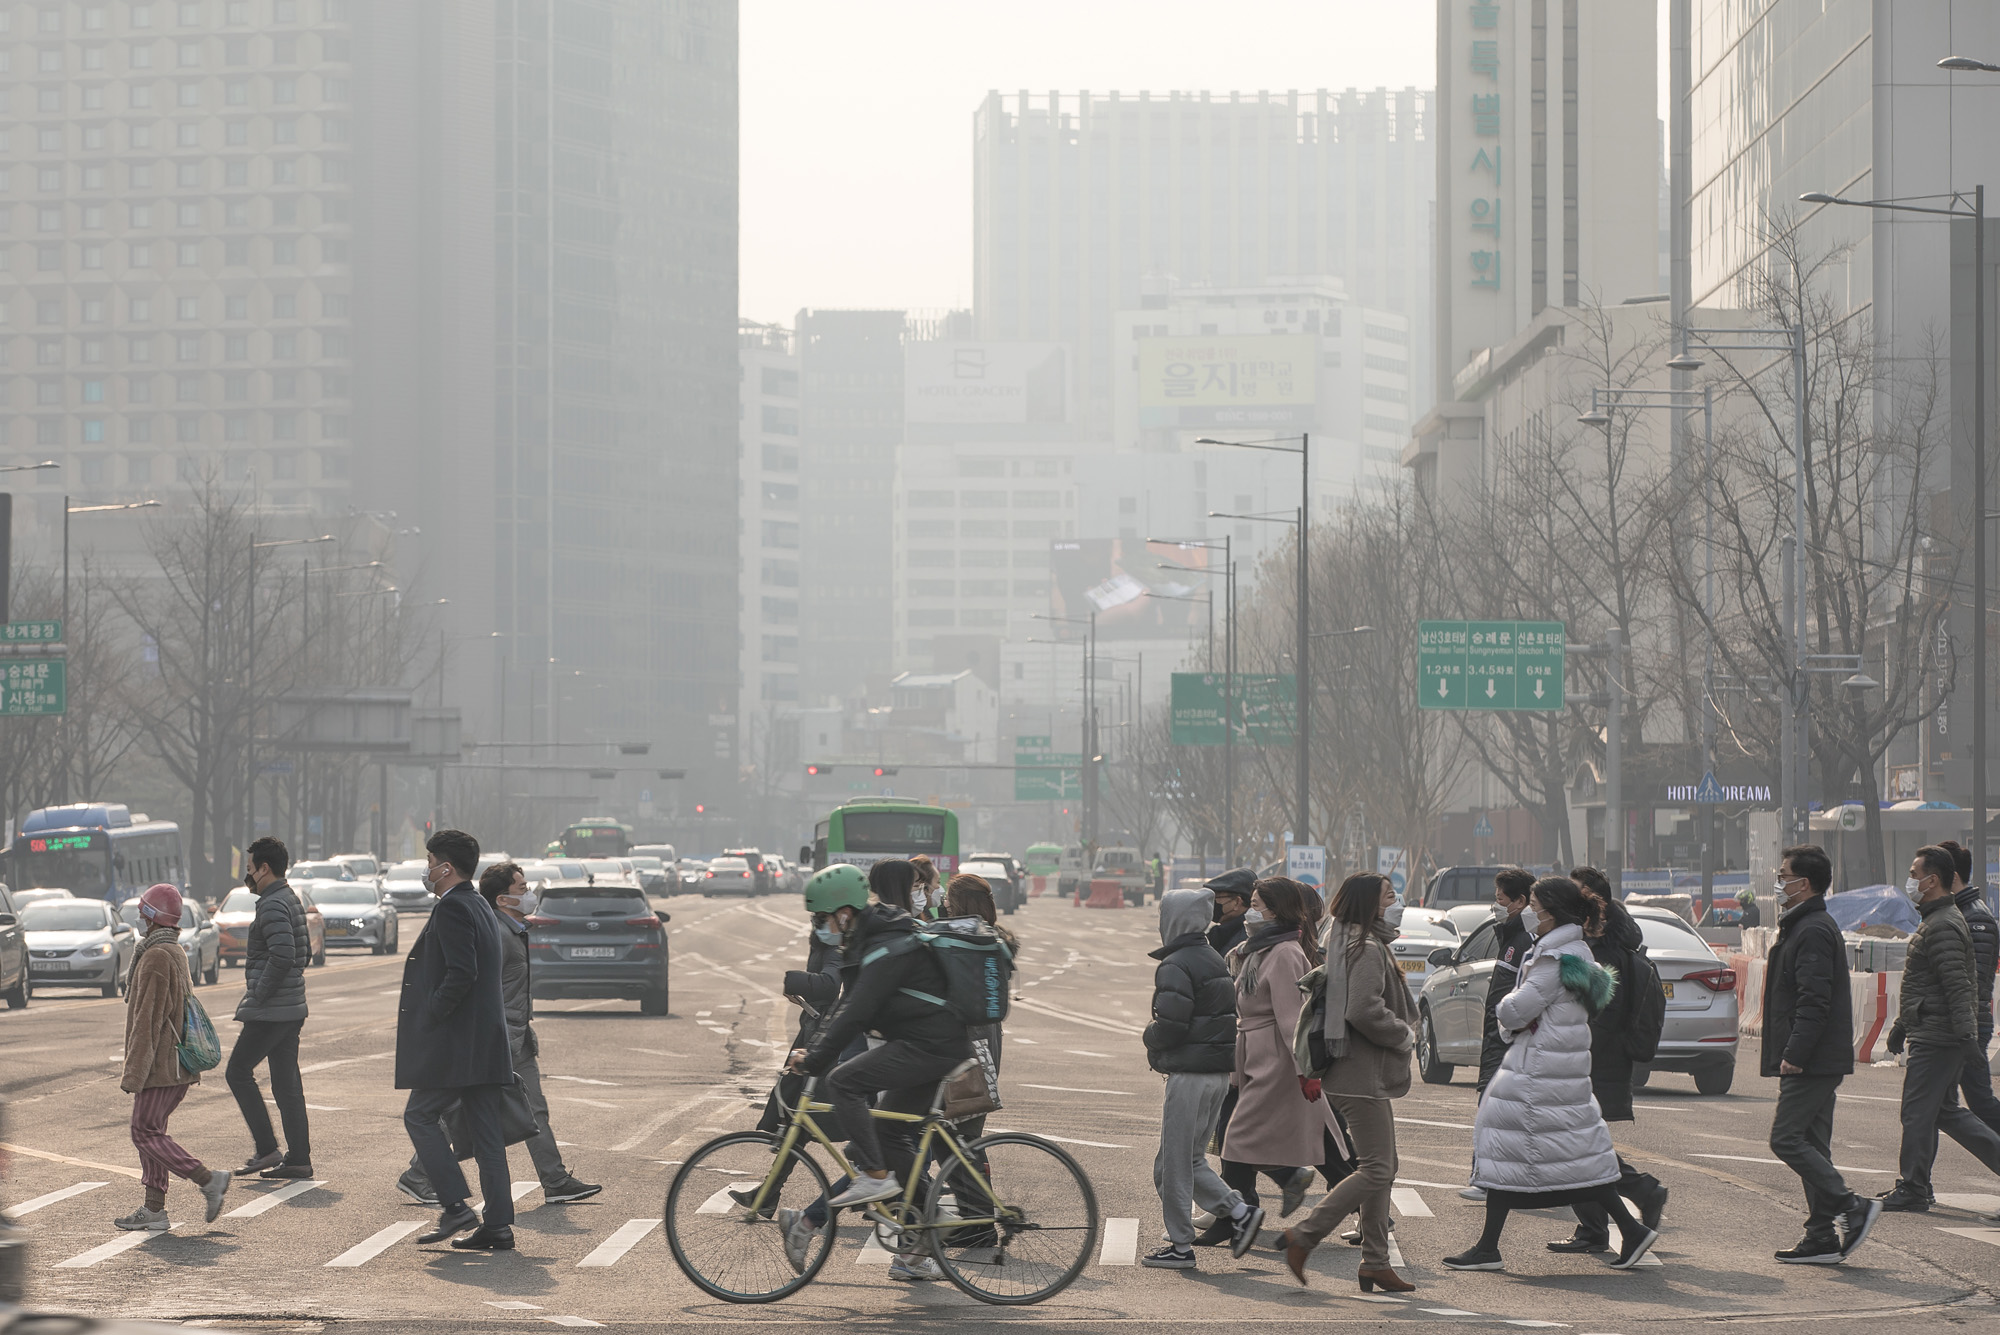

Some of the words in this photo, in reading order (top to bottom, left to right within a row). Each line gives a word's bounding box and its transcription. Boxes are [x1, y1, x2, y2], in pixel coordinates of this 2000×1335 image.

[1161, 361, 1238, 398] 을지
[6, 623, 55, 639] 청계광장
[1421, 630, 1466, 645] 남산3호터널
[1471, 631, 1512, 646] 숭례문
[1517, 631, 1562, 646] 신촌로터리
[1469, 645, 1514, 657] Sungnyemun
[1517, 646, 1544, 656] Sinchon
[8, 663, 50, 679] 숭례문
[1526, 665, 1553, 676] 6차로
[1667, 785, 1697, 801] HOT
[1721, 785, 1771, 801] OREANA
[906, 824, 934, 839] 7011
